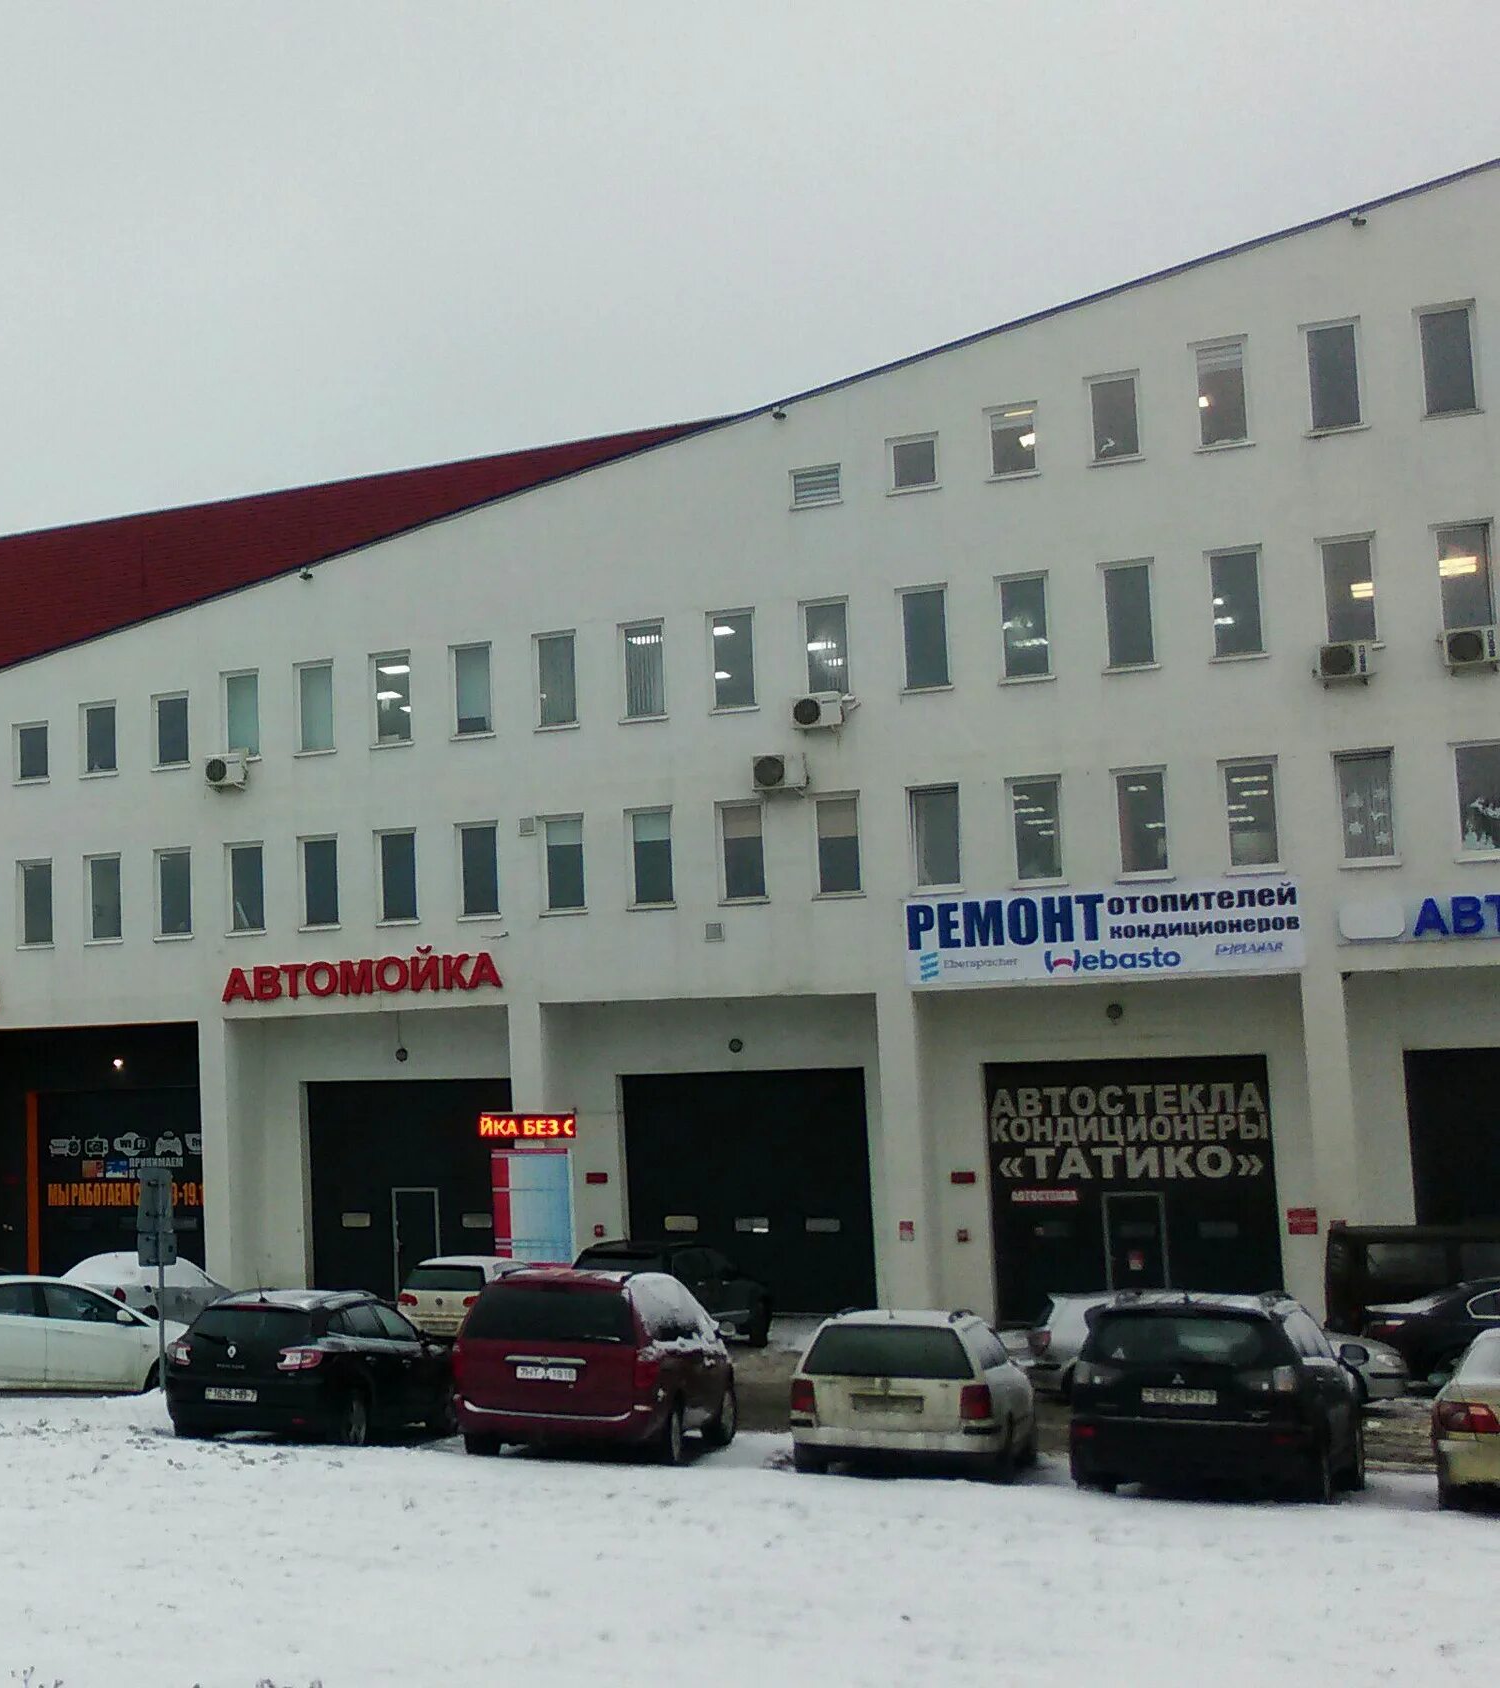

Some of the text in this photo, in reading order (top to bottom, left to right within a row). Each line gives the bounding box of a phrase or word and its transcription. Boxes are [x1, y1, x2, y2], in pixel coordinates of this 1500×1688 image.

[906, 882, 1297, 950] РЕМОНТ отопителей
[1109, 915, 1300, 939] кондиционеров
[222, 945, 503, 1003] АВТОМОЙКА
[1044, 947, 1181, 974] Webasto
[992, 1083, 1265, 1117] АВТОСТЕКЛА
[479, 1117, 518, 1137] ЙКА
[523, 1120, 560, 1136] БЕЗ
[991, 1114, 1268, 1146] КОНДИЦИОНЕРЫ
[1000, 1146, 1264, 1179] «ТАТИКО»
[48, 1184, 69, 1206] МЫ
[71, 1183, 131, 1206] РАБОТАЕМ
